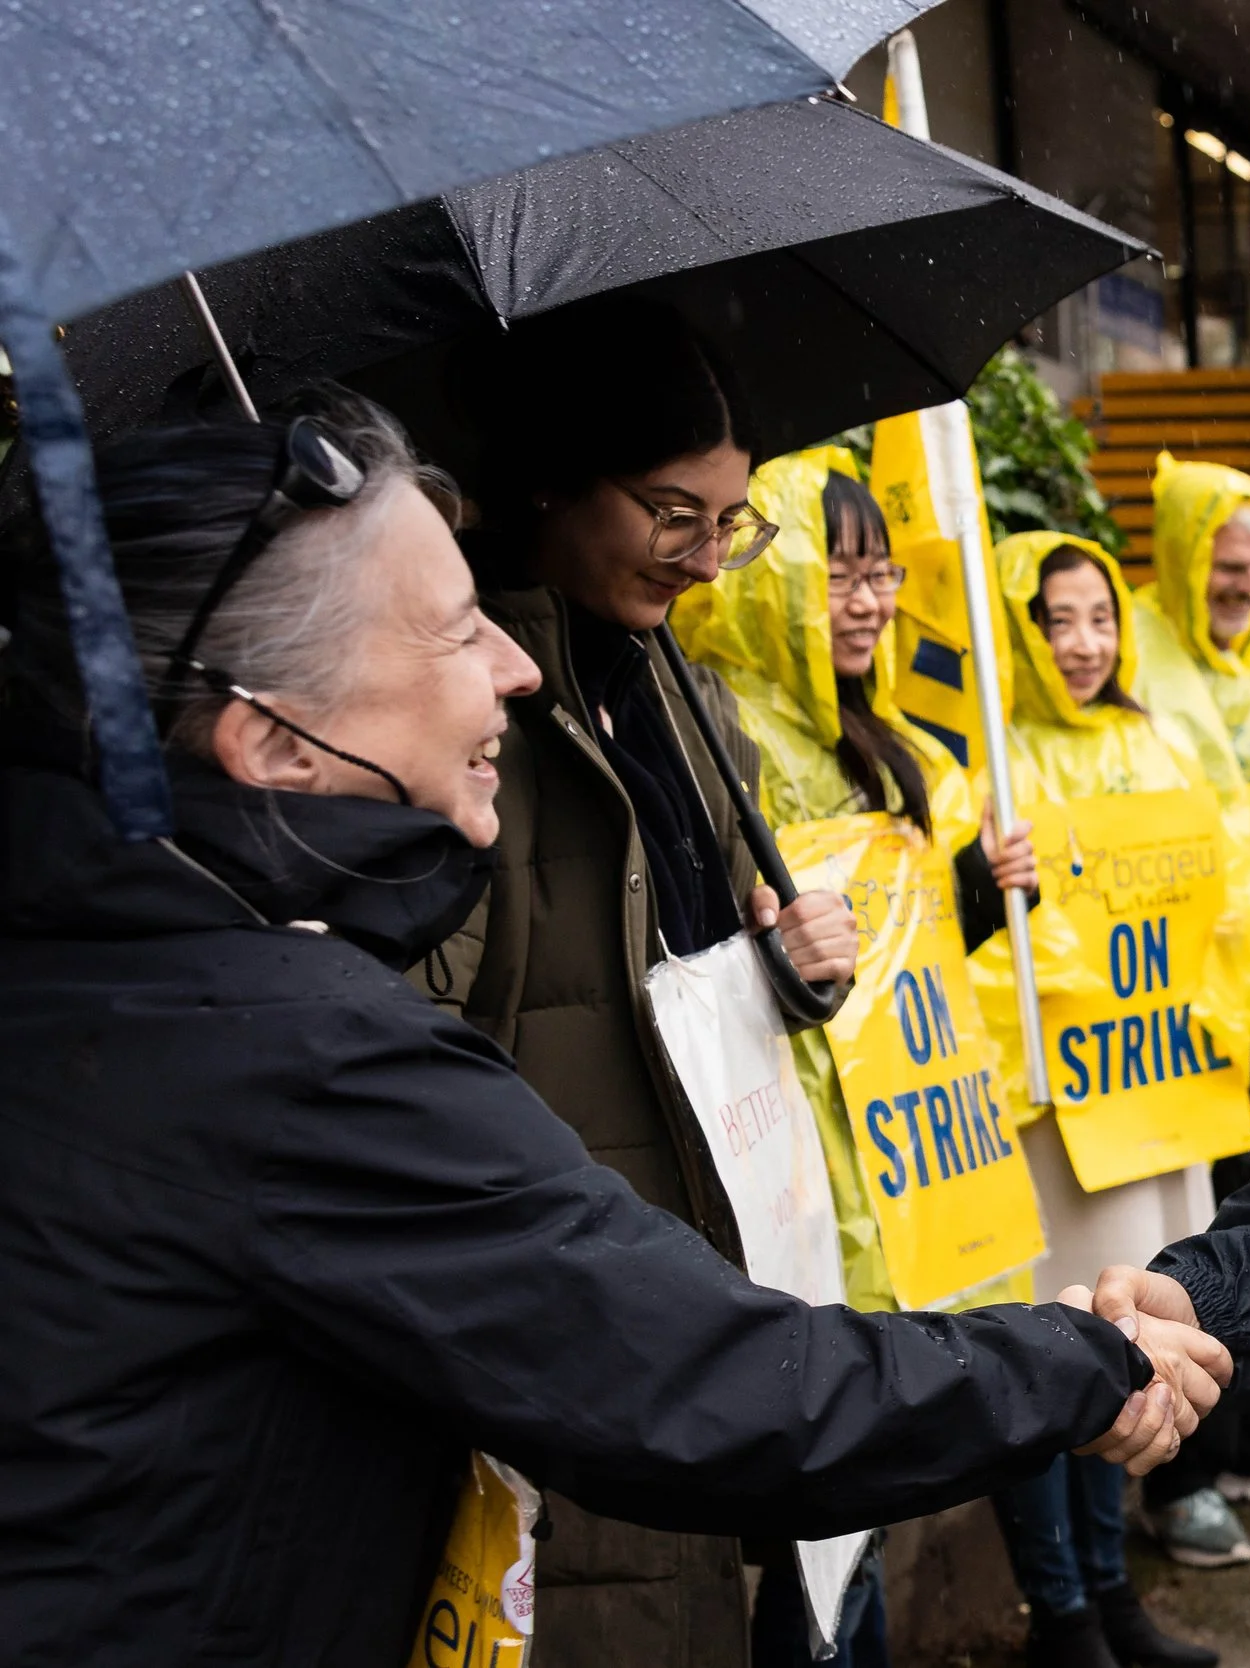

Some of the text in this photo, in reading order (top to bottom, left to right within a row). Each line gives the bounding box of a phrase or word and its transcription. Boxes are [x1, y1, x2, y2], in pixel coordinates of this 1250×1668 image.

[1109, 916, 1169, 1000] ON
[894, 963, 958, 1066] ON
[866, 1069, 1013, 1199] STRIKE
